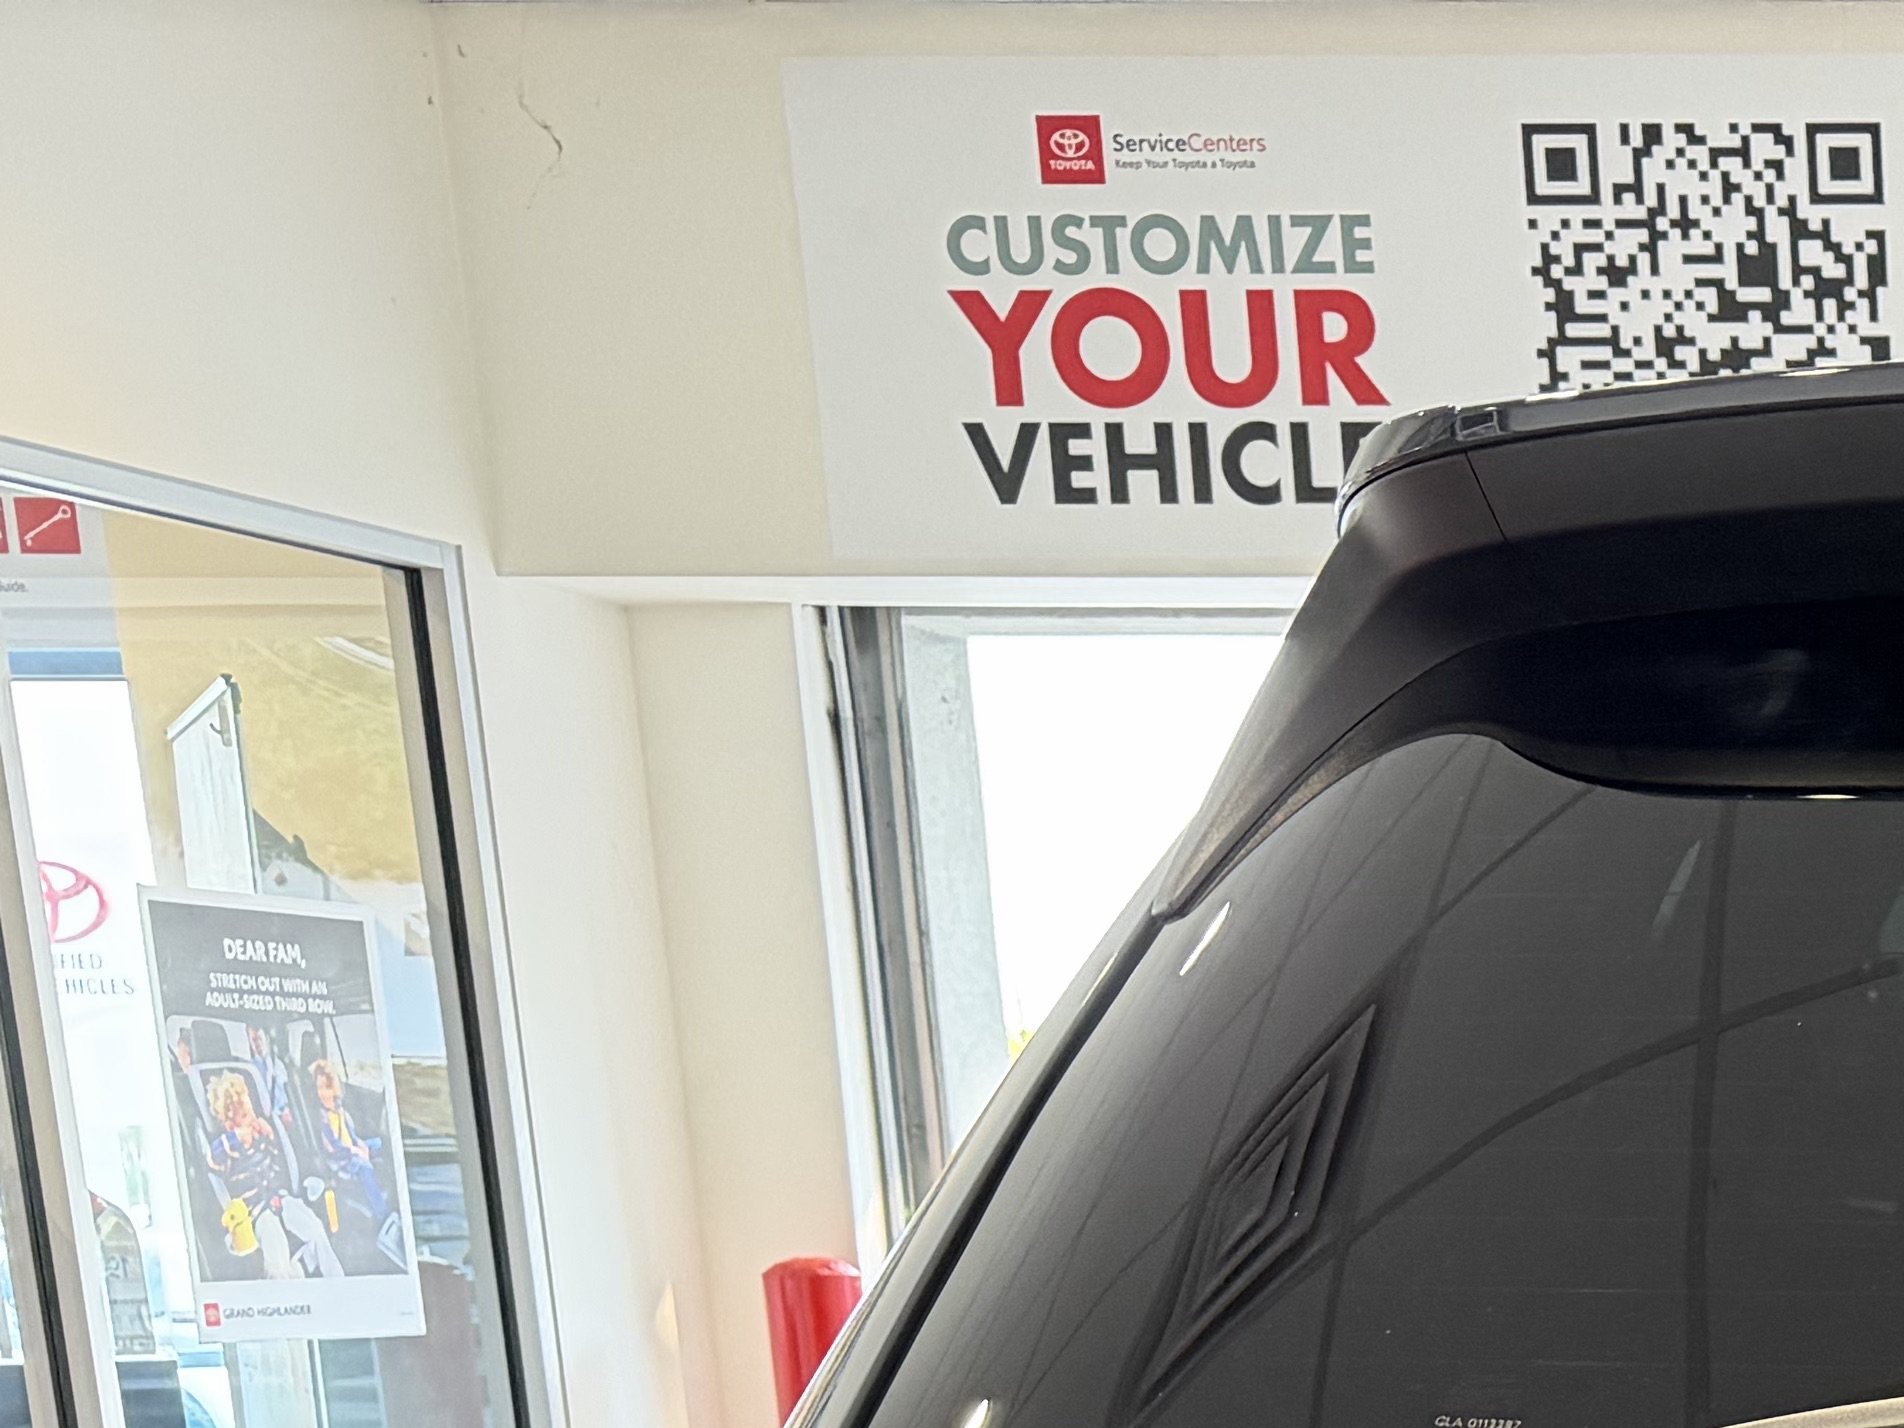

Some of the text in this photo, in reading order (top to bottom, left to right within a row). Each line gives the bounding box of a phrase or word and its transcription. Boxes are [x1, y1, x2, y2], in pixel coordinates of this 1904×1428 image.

[1112, 133, 1267, 153] ServiceCenters
[1049, 159, 1095, 171] TOYOTA
[1115, 159, 1142, 171] Keep
[1145, 159, 1168, 169] Your
[1172, 159, 1207, 171] Toyota
[1220, 159, 1256, 171] Toyota
[947, 213, 1375, 276] CUSTOMIZE
[947, 287, 1392, 409] YOUR
[223, 937, 306, 969] DEAR FAM,
[209, 971, 257, 990] STRETCH
[257, 975, 280, 992] OUT
[281, 977, 310, 995] WITH
